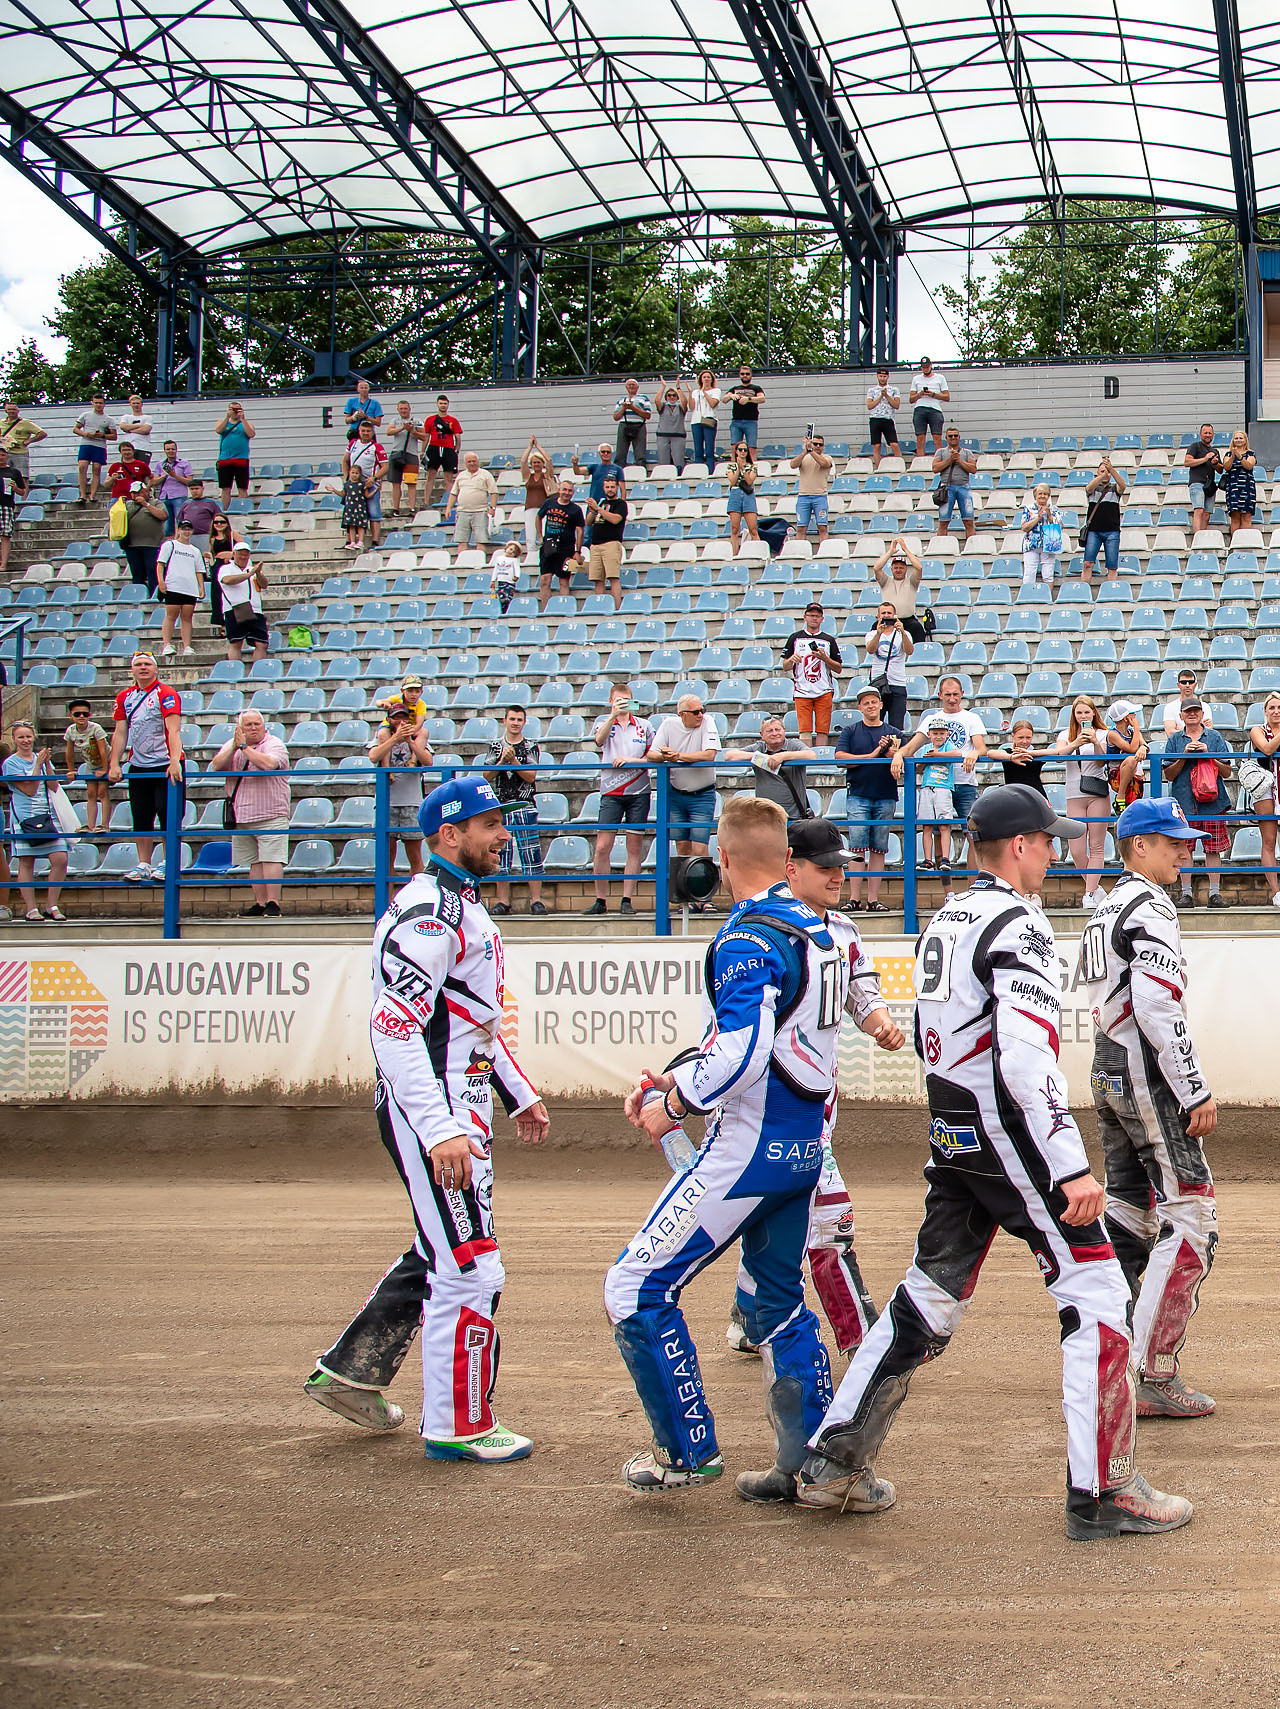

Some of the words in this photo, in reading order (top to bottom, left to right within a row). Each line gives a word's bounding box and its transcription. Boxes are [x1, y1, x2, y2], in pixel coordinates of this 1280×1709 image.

[1104, 376, 1120, 399] D
[322, 406, 333, 428] E
[923, 936, 944, 994] 9
[1084, 926, 1102, 978] 10
[124, 962, 310, 996] DAUGAVPILS
[535, 961, 701, 996] DAUGAVPIL
[714, 958, 764, 991] SAGARI
[1020, 994, 1055, 1014] FAMILY
[124, 1010, 146, 1044] IS
[158, 1010, 296, 1044] SPEEDWAY
[375, 1008, 414, 1034] NGK
[535, 1010, 558, 1044] IR
[572, 1010, 678, 1045] SPORTS
[1092, 1078, 1115, 1092] REALL
[766, 1142, 822, 1160] SAGA
[458, 1219, 470, 1239] CO.
[636, 1178, 707, 1263] SAGARI
[665, 1213, 697, 1252] SPORTS
[471, 1349, 479, 1371] LAURITZ
[471, 1372, 479, 1402] ANDERSEN
[661, 1328, 707, 1444] SAGARI
